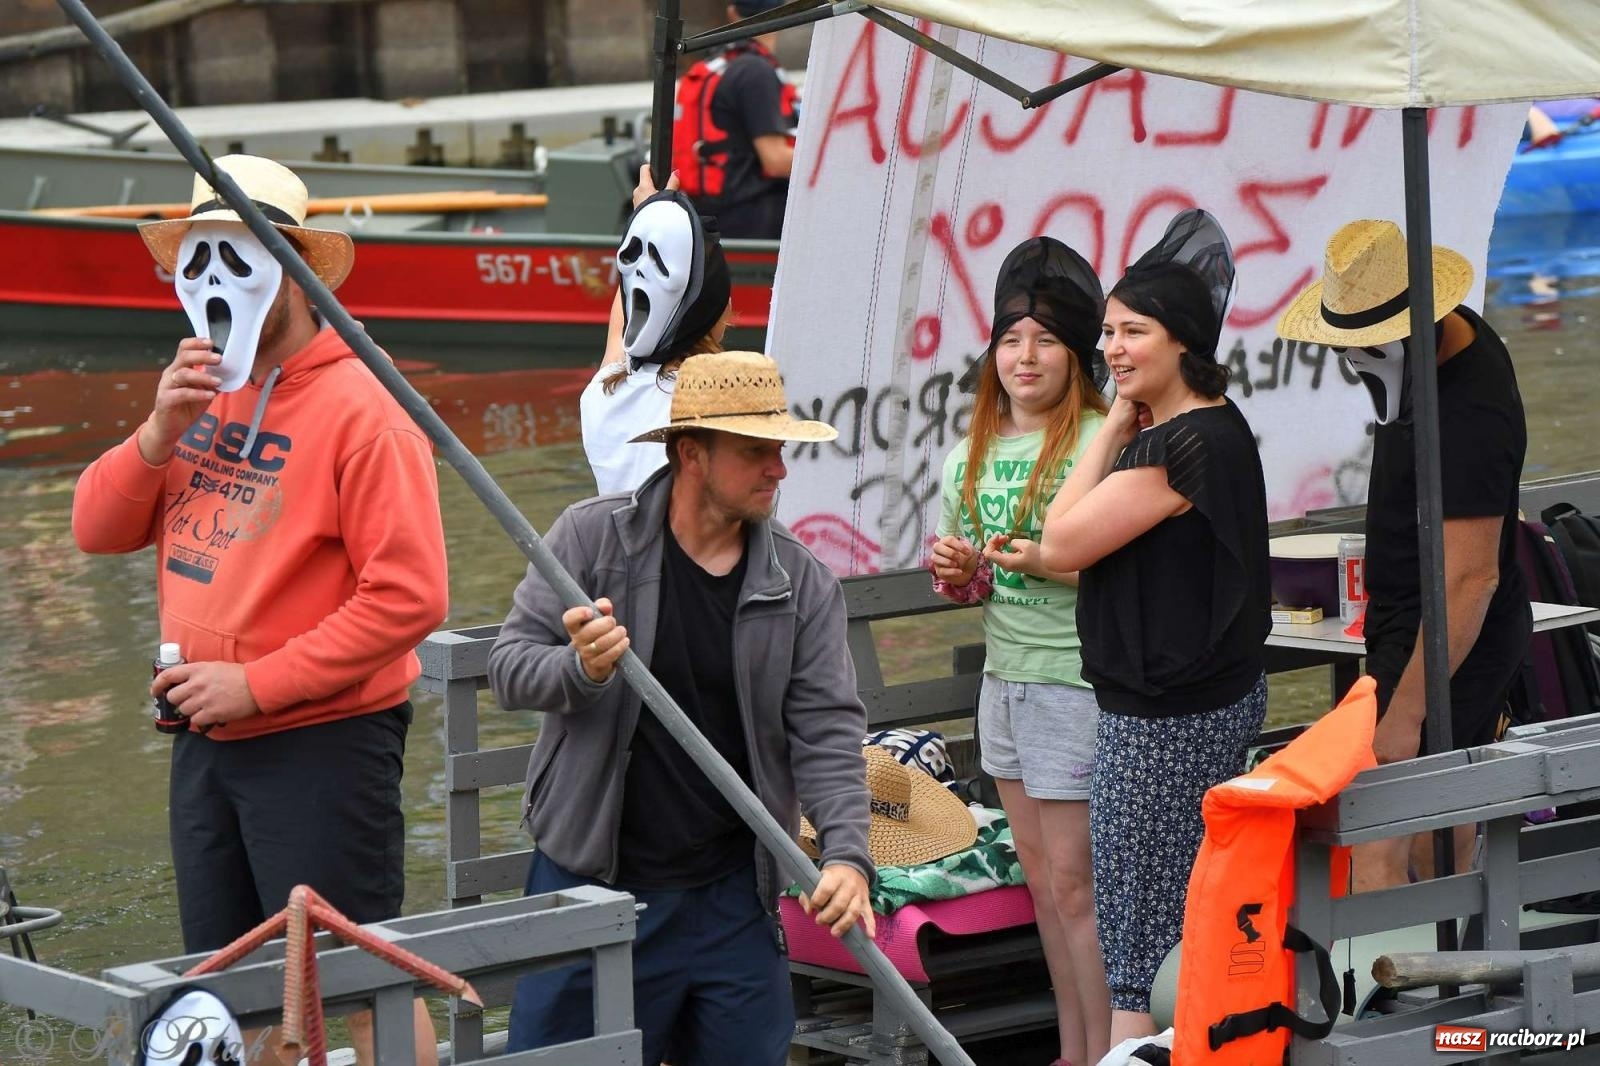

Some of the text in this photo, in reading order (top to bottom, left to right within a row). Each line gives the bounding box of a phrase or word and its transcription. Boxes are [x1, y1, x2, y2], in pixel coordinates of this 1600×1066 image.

[180, 412, 292, 473] BSC
[200, 454, 236, 478] SAILING
[235, 467, 279, 487] COMPANY
[993, 459, 1073, 482] WHT
[219, 481, 256, 505] 470
[1007, 596, 1049, 606] HAPPY
